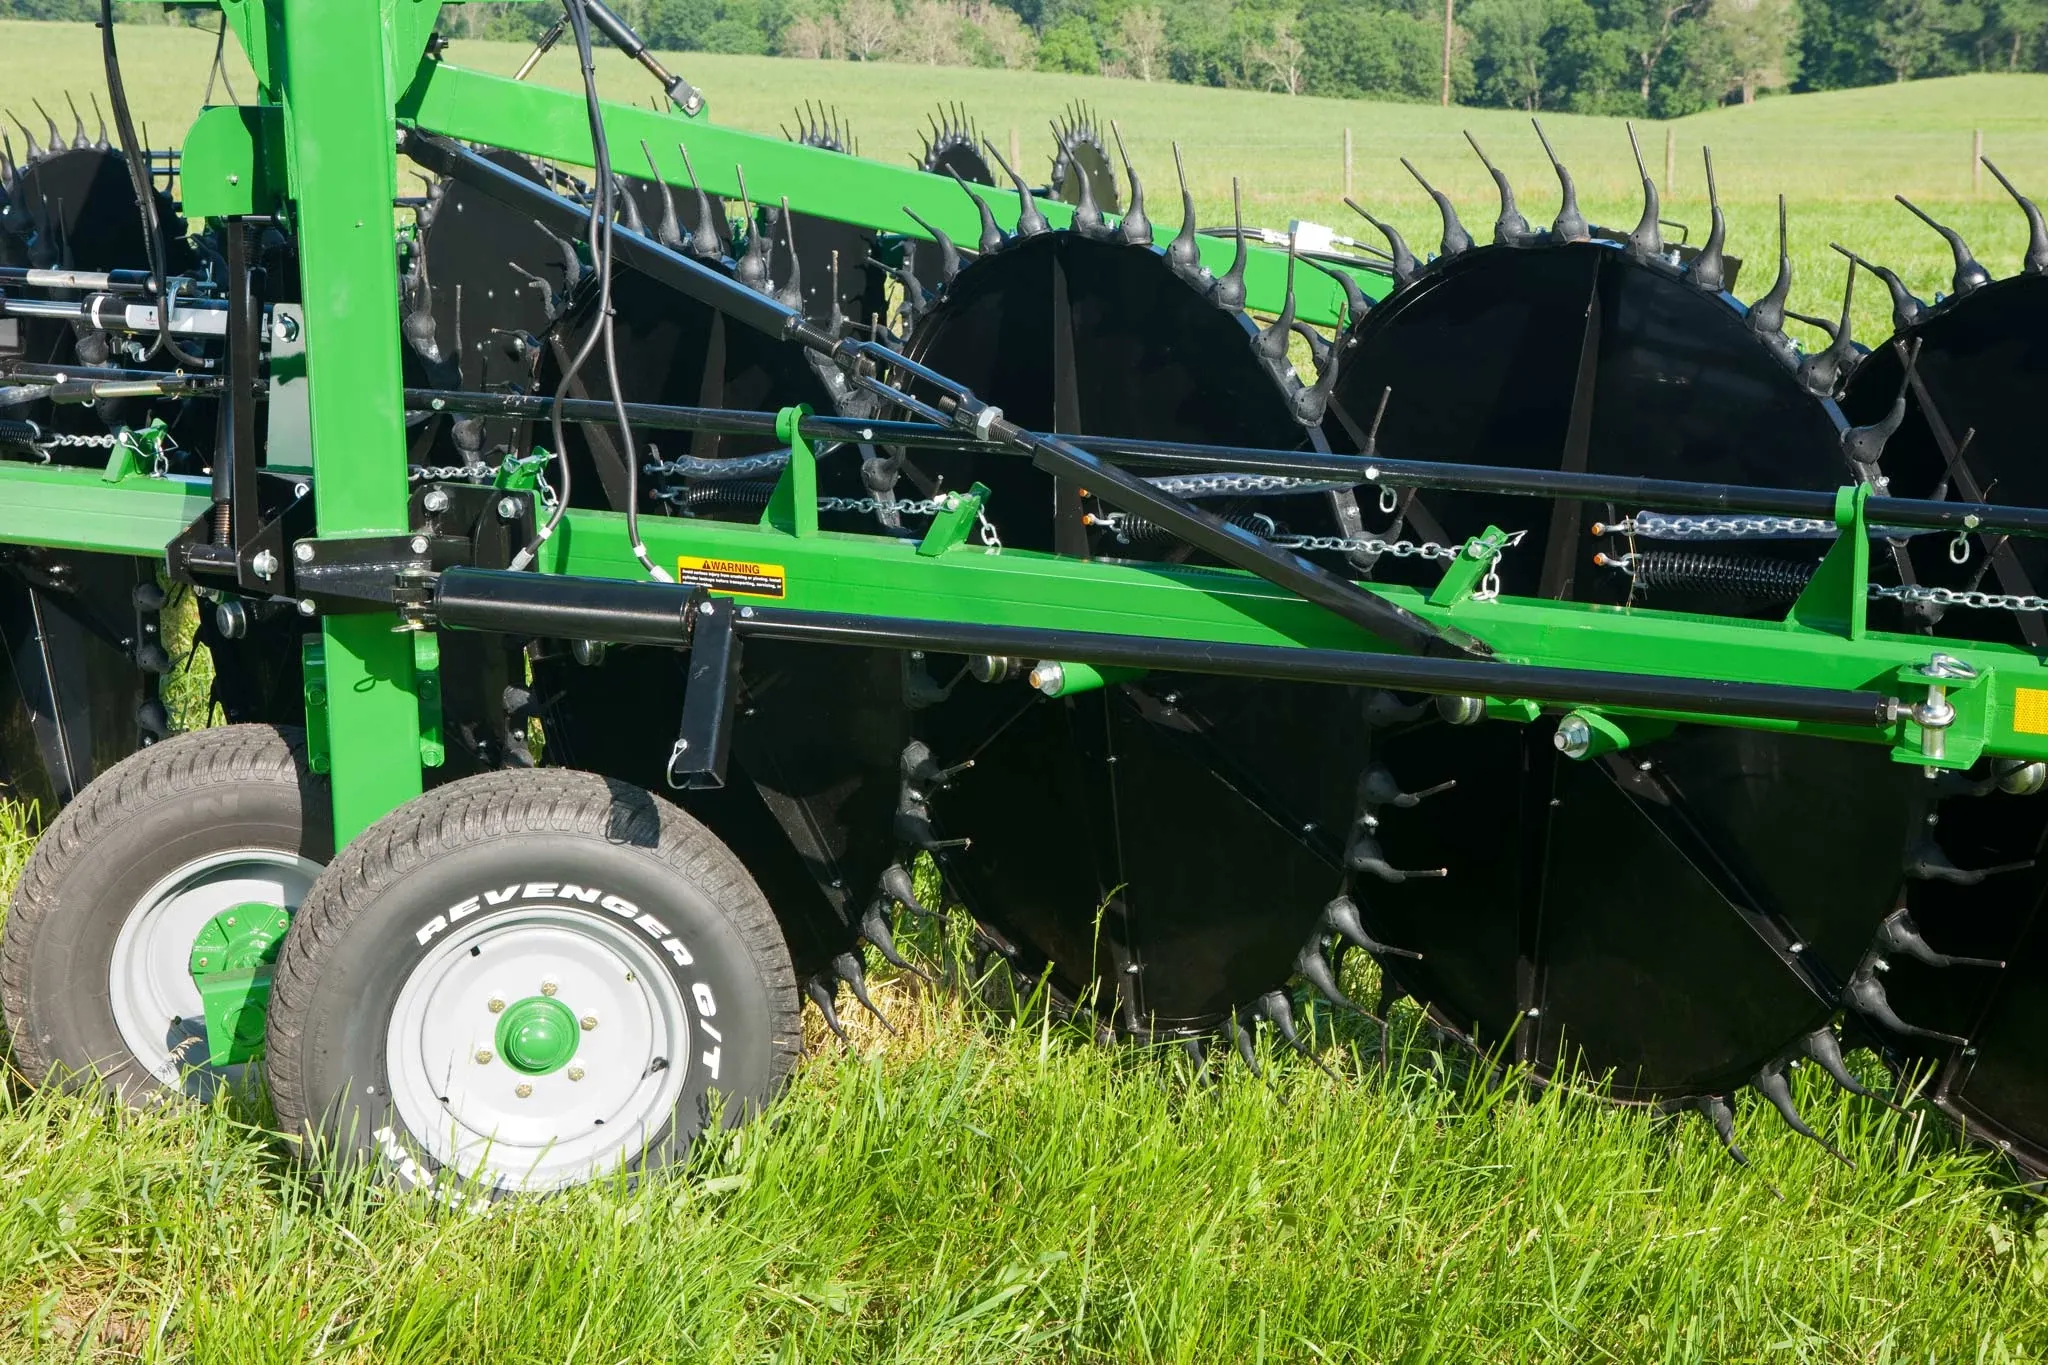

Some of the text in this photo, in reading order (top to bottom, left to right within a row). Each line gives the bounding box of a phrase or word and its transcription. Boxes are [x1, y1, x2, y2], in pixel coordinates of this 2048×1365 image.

[711, 561, 760, 574] WARNING
[415, 882, 722, 1080] REVENGER G/T
